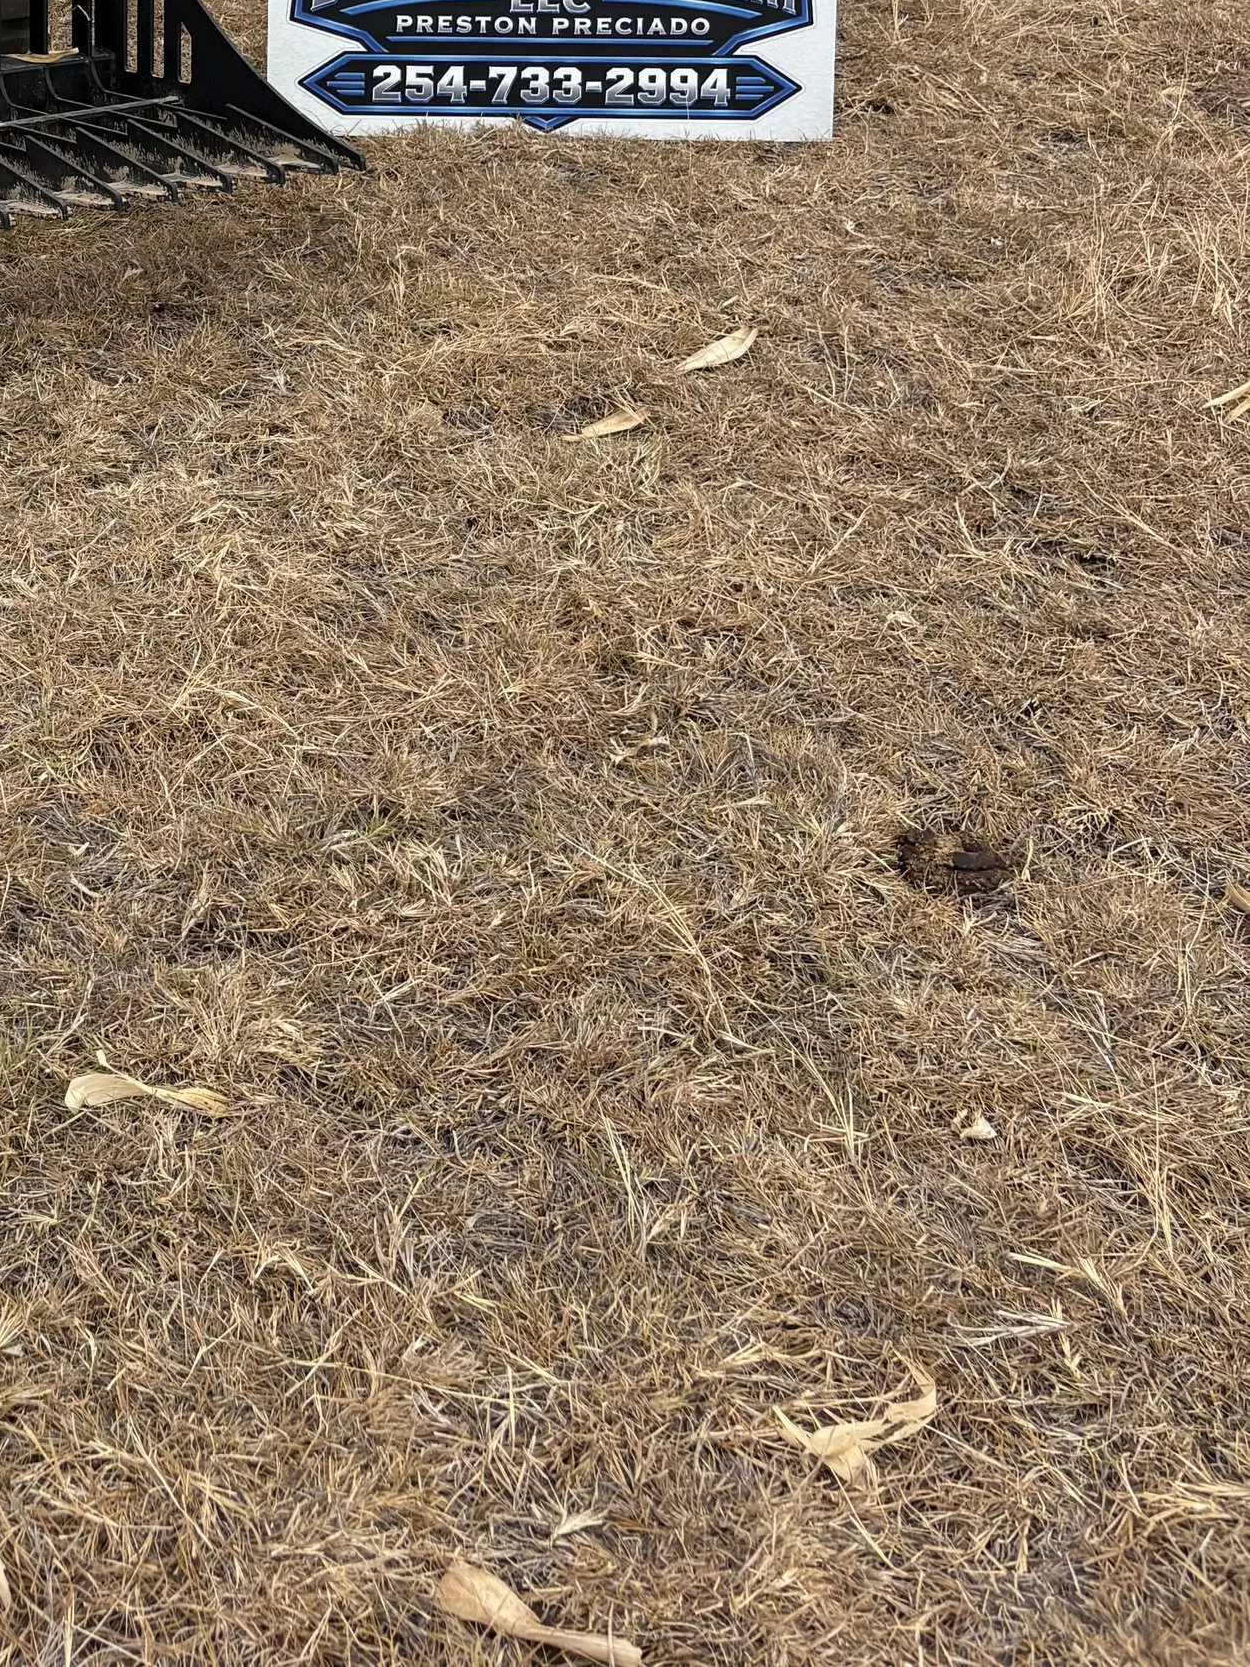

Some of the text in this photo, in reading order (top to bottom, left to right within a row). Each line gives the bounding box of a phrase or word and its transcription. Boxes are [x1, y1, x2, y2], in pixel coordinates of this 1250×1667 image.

[395, 15, 712, 36] PRESTON PRECIADO
[372, 65, 732, 108] 254-733-2994
